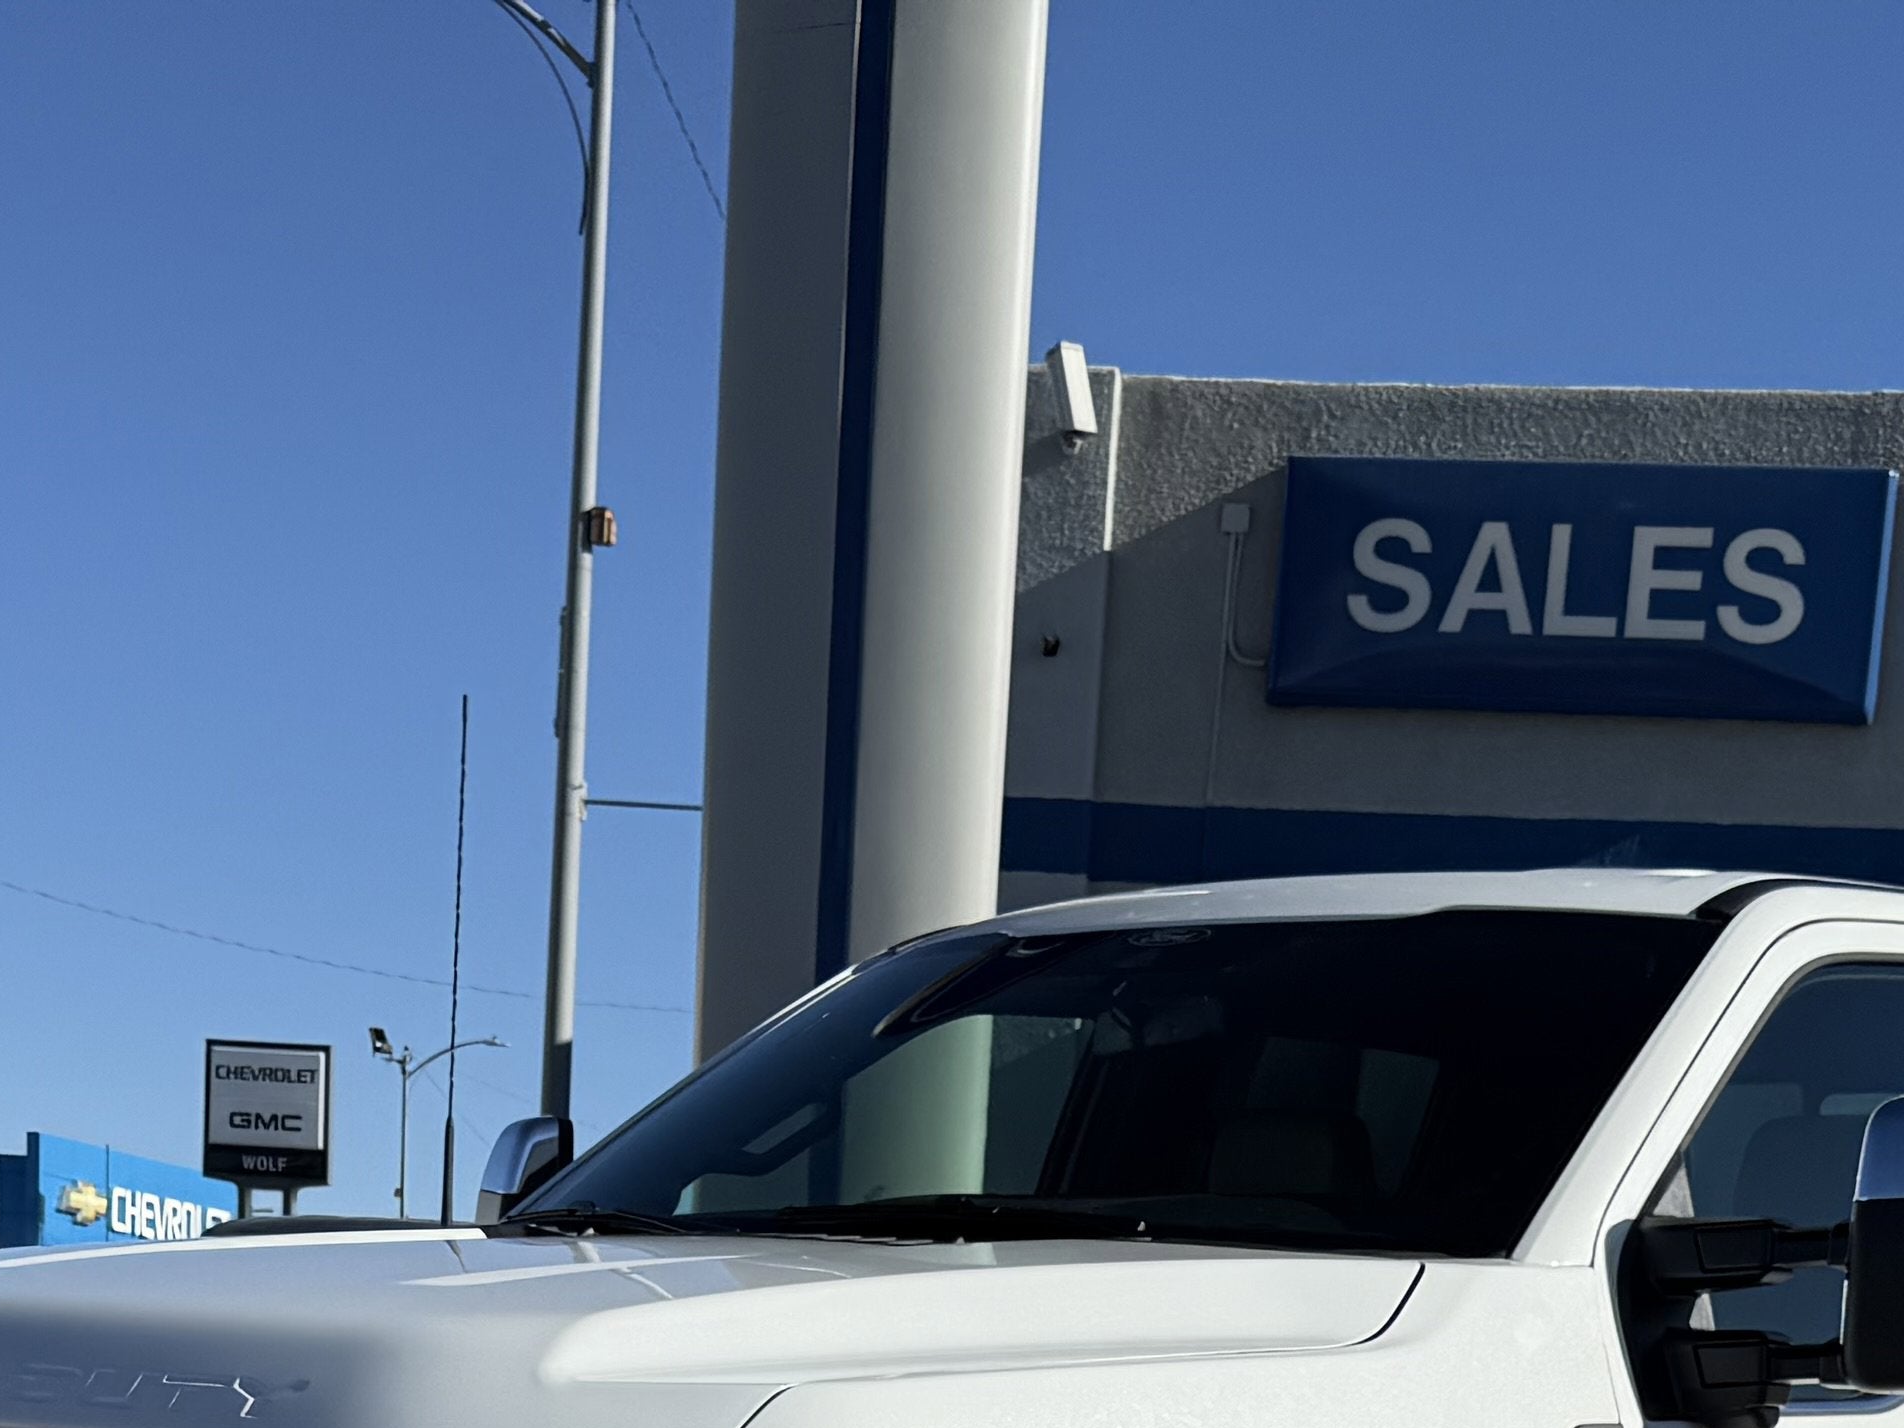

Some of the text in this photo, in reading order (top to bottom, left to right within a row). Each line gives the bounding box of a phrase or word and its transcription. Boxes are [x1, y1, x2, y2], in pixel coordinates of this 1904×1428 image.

[1346, 517, 1806, 645] SALES
[215, 1064, 319, 1084] CHEVROLET
[229, 1111, 303, 1132] GMC
[242, 1154, 288, 1172] WOLF
[111, 1186, 232, 1240] CHEVROL
